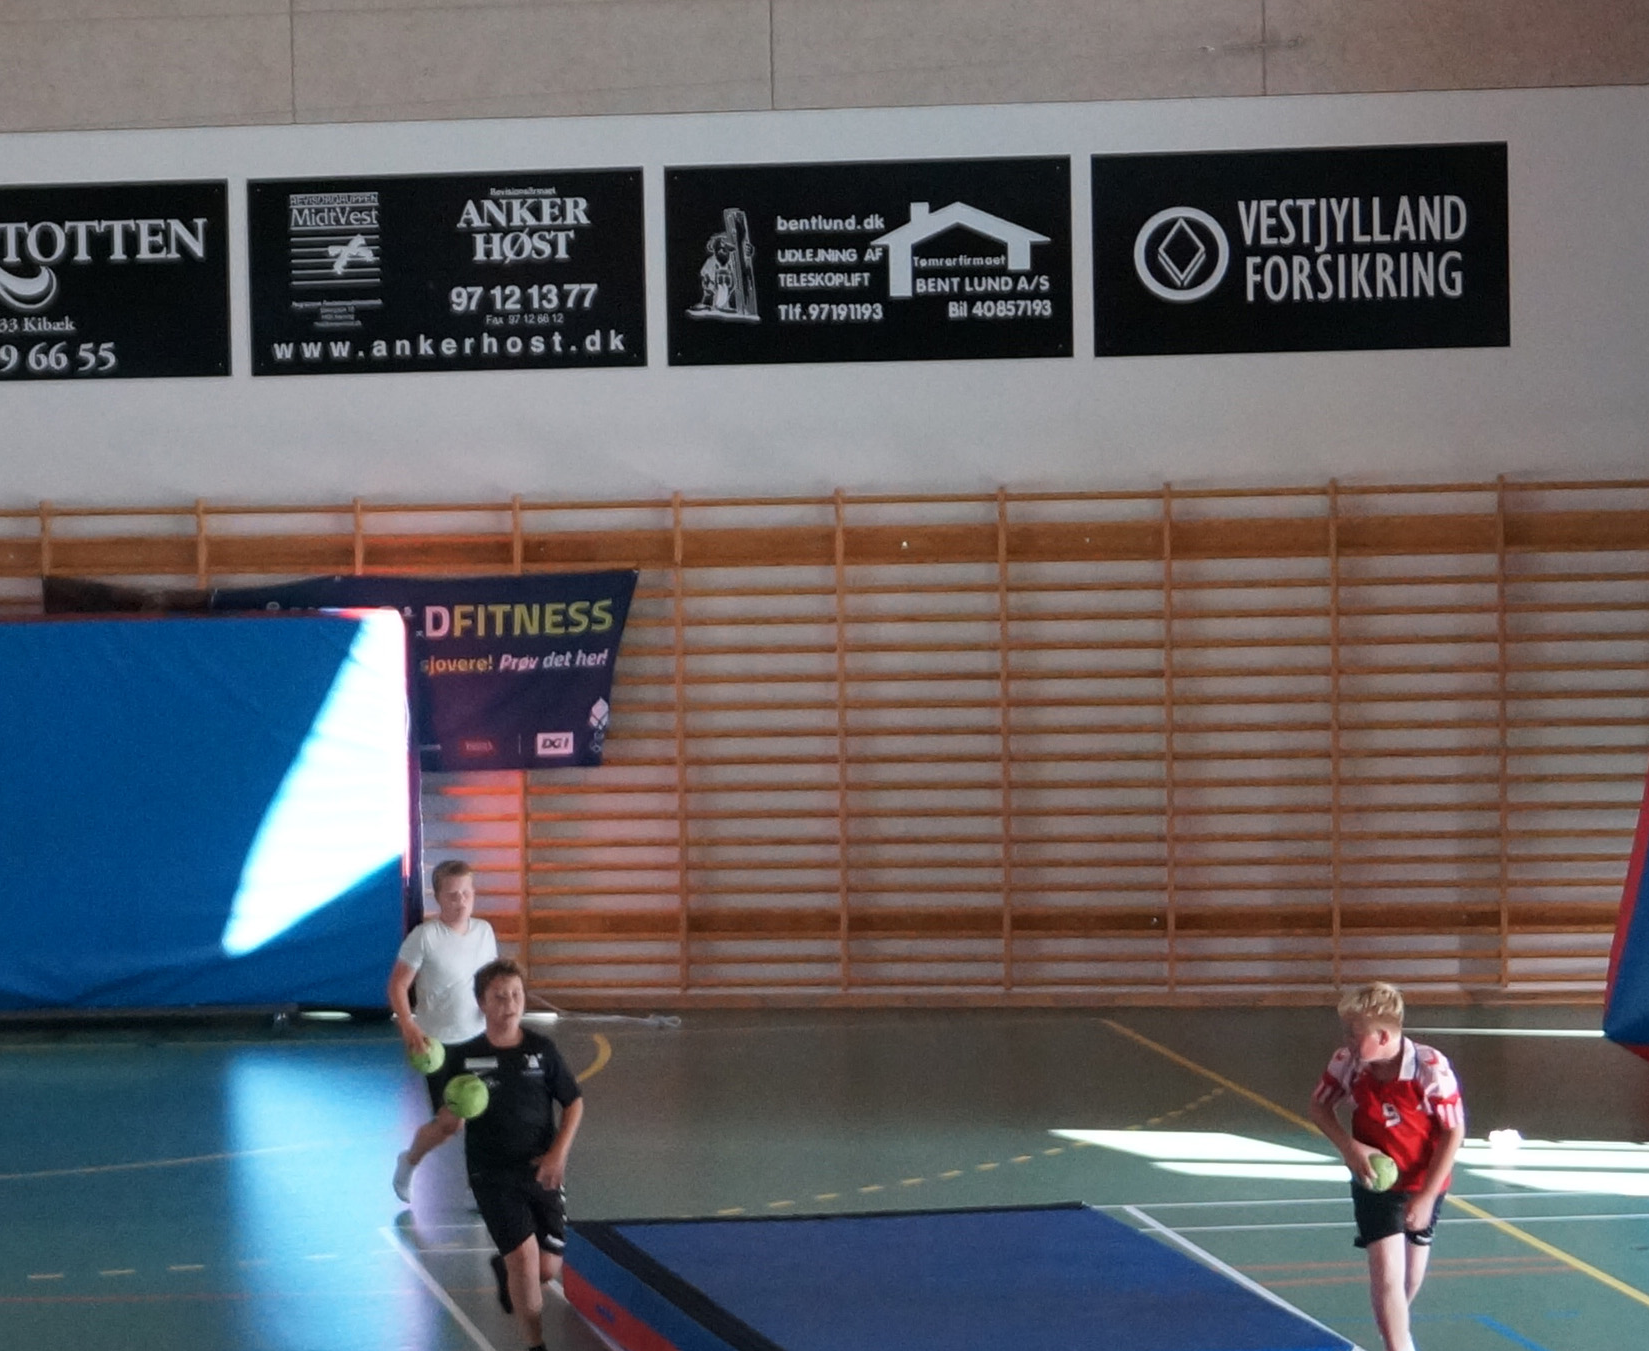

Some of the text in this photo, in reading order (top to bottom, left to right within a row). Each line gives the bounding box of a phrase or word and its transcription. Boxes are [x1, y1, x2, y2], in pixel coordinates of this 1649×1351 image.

[290, 208, 377, 226] MidtVest
[457, 197, 590, 228] ANKER
[777, 214, 885, 231] bentlund.dk
[1238, 195, 1467, 252] VESTJYLLAND
[473, 230, 575, 264] HØST
[778, 248, 883, 263] UDLEJNING AF
[779, 273, 870, 286] TELESKOPLIFT
[916, 276, 1049, 292] BENT LUND A/S
[1245, 251, 1463, 301] FORSIKRING
[451, 283, 597, 312] 97 12 13 77
[949, 301, 1051, 318] Bil 40857193
[22, 316, 75, 331] Kibæk
[486, 314, 503, 325] Fax
[524, 314, 535, 323] 12
[553, 313, 563, 323] 12
[272, 329, 625, 360] www.ankerhost.dk
[28, 342, 68, 370] 66
[78, 341, 116, 370] 55
[500, 654, 539, 671] Prøv
[543, 652, 570, 667] det
[576, 648, 609, 666] her!
[542, 737, 569, 749] DGI
